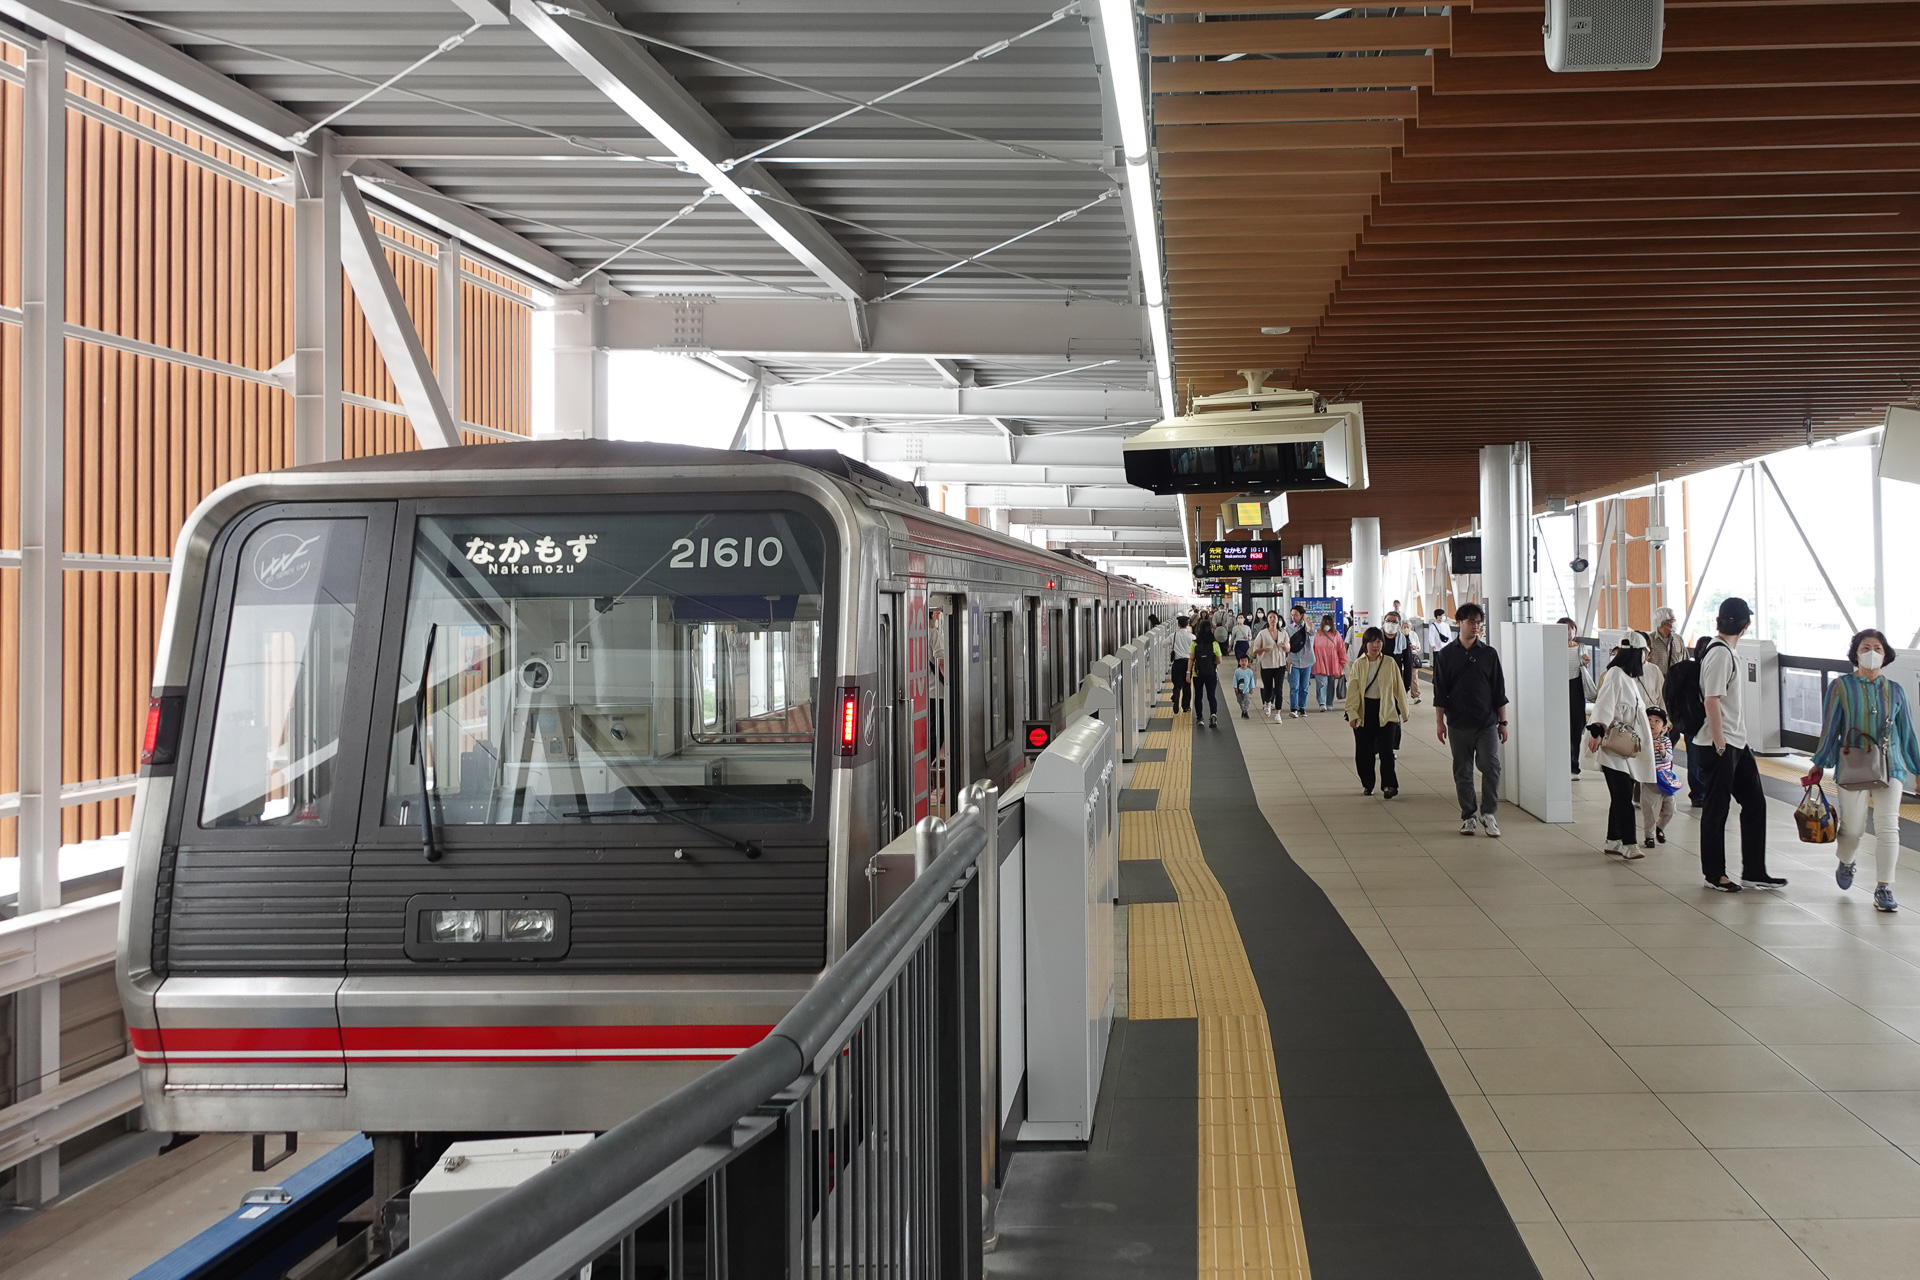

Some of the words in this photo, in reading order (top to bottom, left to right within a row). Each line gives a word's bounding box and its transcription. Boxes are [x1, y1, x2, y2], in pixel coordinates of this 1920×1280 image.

[466, 534, 598, 564] なかもず
[670, 536, 783, 568] 21610
[488, 563, 574, 575] Nakamozu
